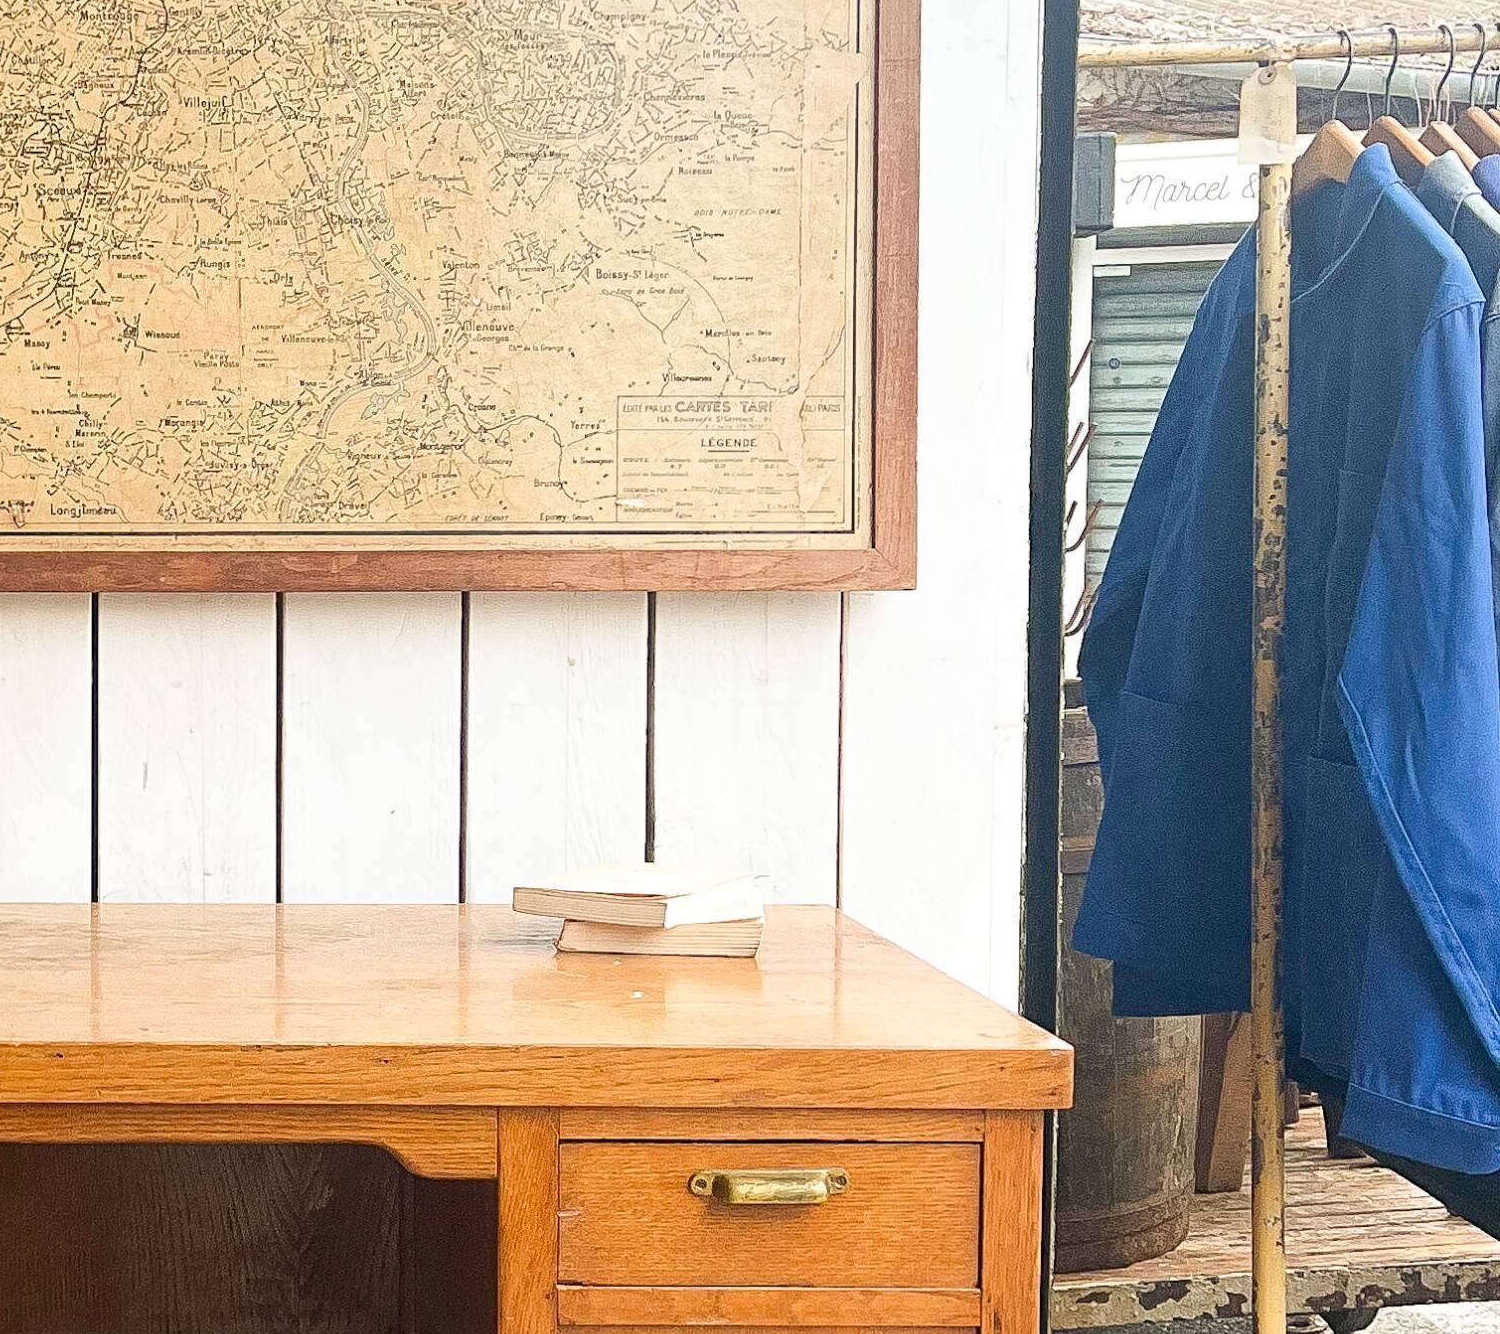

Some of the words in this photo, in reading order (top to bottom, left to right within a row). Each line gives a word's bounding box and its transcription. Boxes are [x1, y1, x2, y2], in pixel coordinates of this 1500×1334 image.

[1120, 174, 1230, 211] Marcel
[674, 400, 731, 413] CARTES
[700, 437, 758, 448] LÉGENDE
